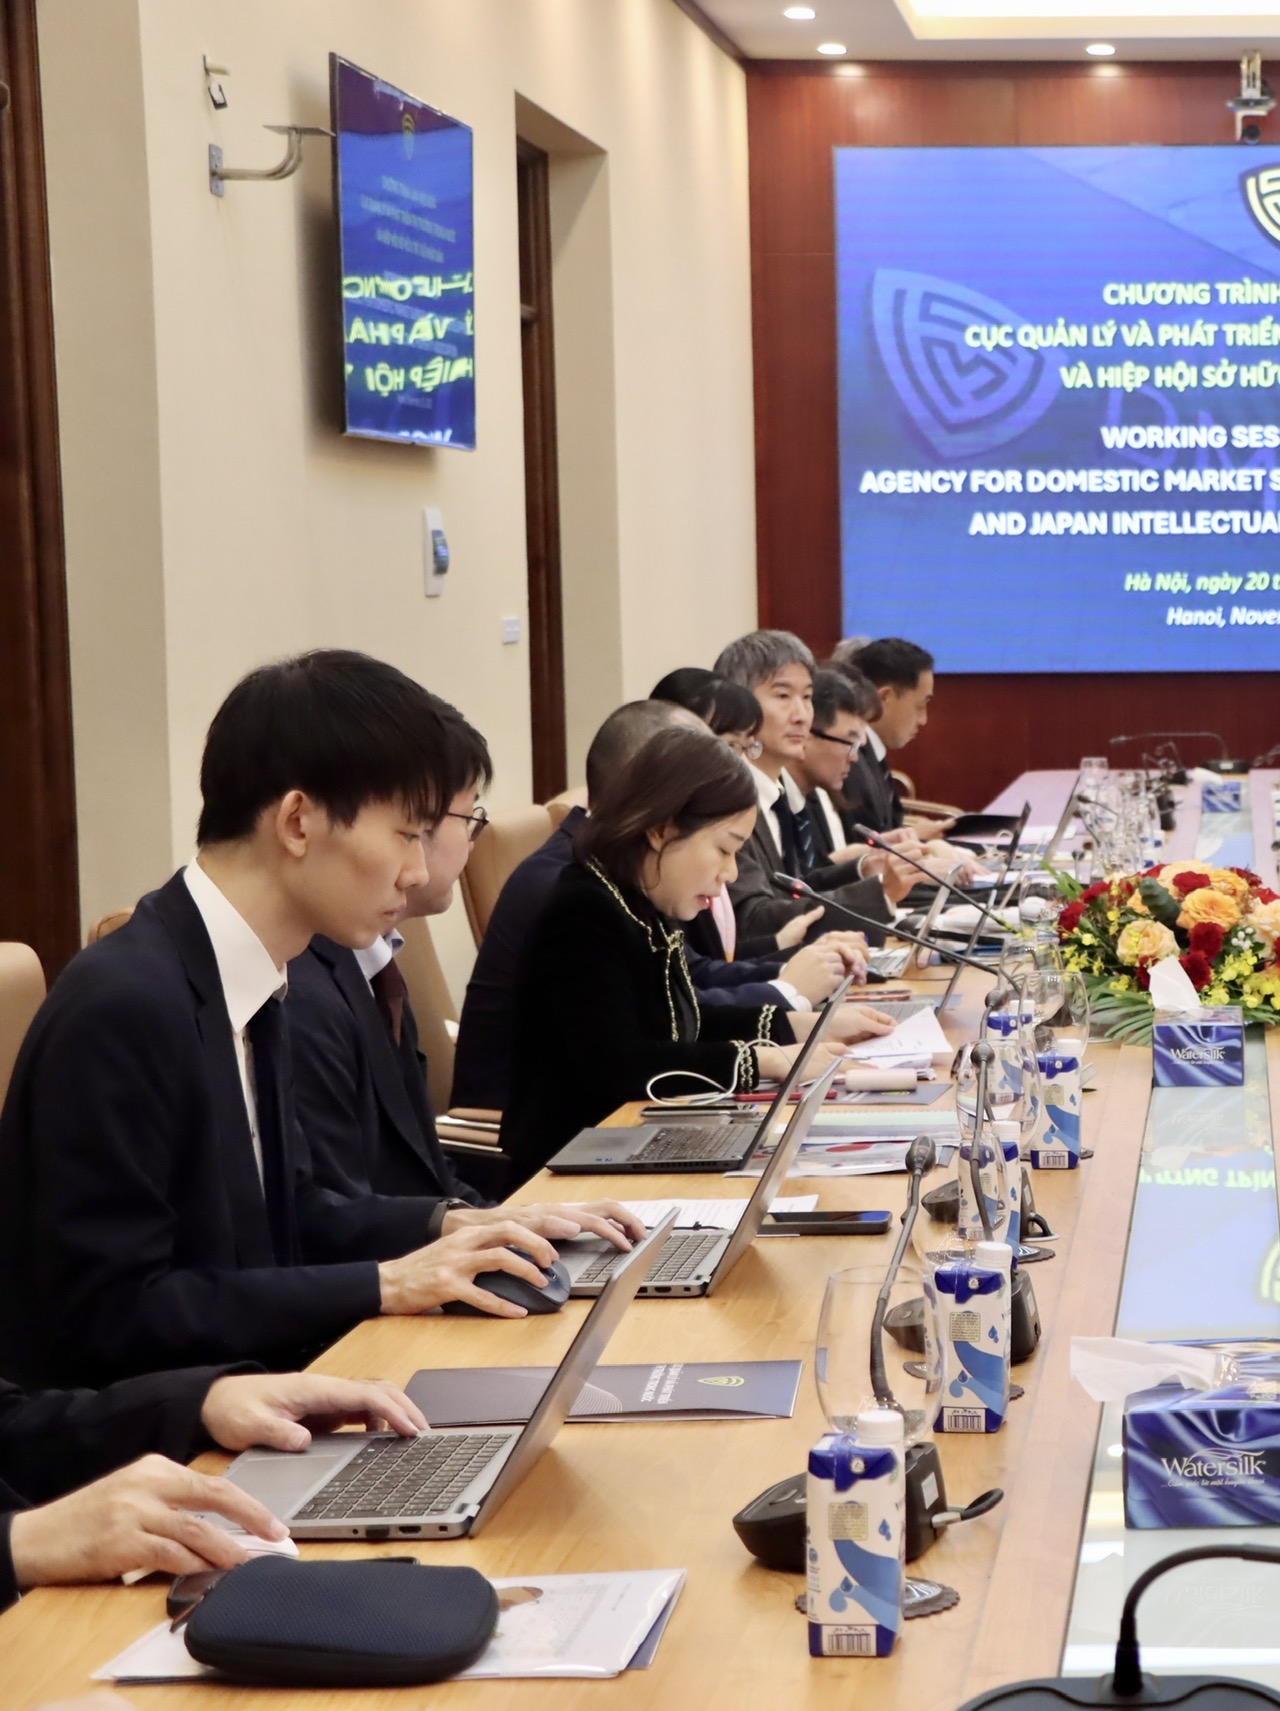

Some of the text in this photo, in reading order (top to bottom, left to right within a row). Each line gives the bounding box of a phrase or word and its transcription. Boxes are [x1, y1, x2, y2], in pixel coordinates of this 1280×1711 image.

[1102, 281, 1211, 306] CHƯƠNG
[963, 323, 1014, 352] CỤC
[1016, 317, 1088, 350] QUẢN
[1091, 319, 1118, 347] LÝ
[1120, 318, 1155, 347] VÀ
[1157, 318, 1219, 347] PHÁT
[1058, 361, 1094, 389] VÀ
[1096, 360, 1151, 393] HIỆP
[1154, 360, 1198, 393] HỘI
[1201, 358, 1238, 388] SỞ
[1100, 425, 1228, 449] WORKING
[859, 469, 968, 494] AGENCY
[970, 469, 1024, 493] FOR
[1026, 469, 1160, 493] DOMESTIC
[1164, 468, 1267, 492] MARKET
[968, 511, 1027, 536] AND
[1028, 511, 1108, 536] JAPAN
[1124, 572, 1152, 592] Hà
[1154, 571, 1192, 594] Nội,
[1195, 572, 1243, 595] ngày
[1244, 571, 1270, 591] 20
[1166, 607, 1226, 628] Hanoi,
[1170, 1046, 1226, 1060] Watersilk
[1161, 1453, 1265, 1478] Watersilk
